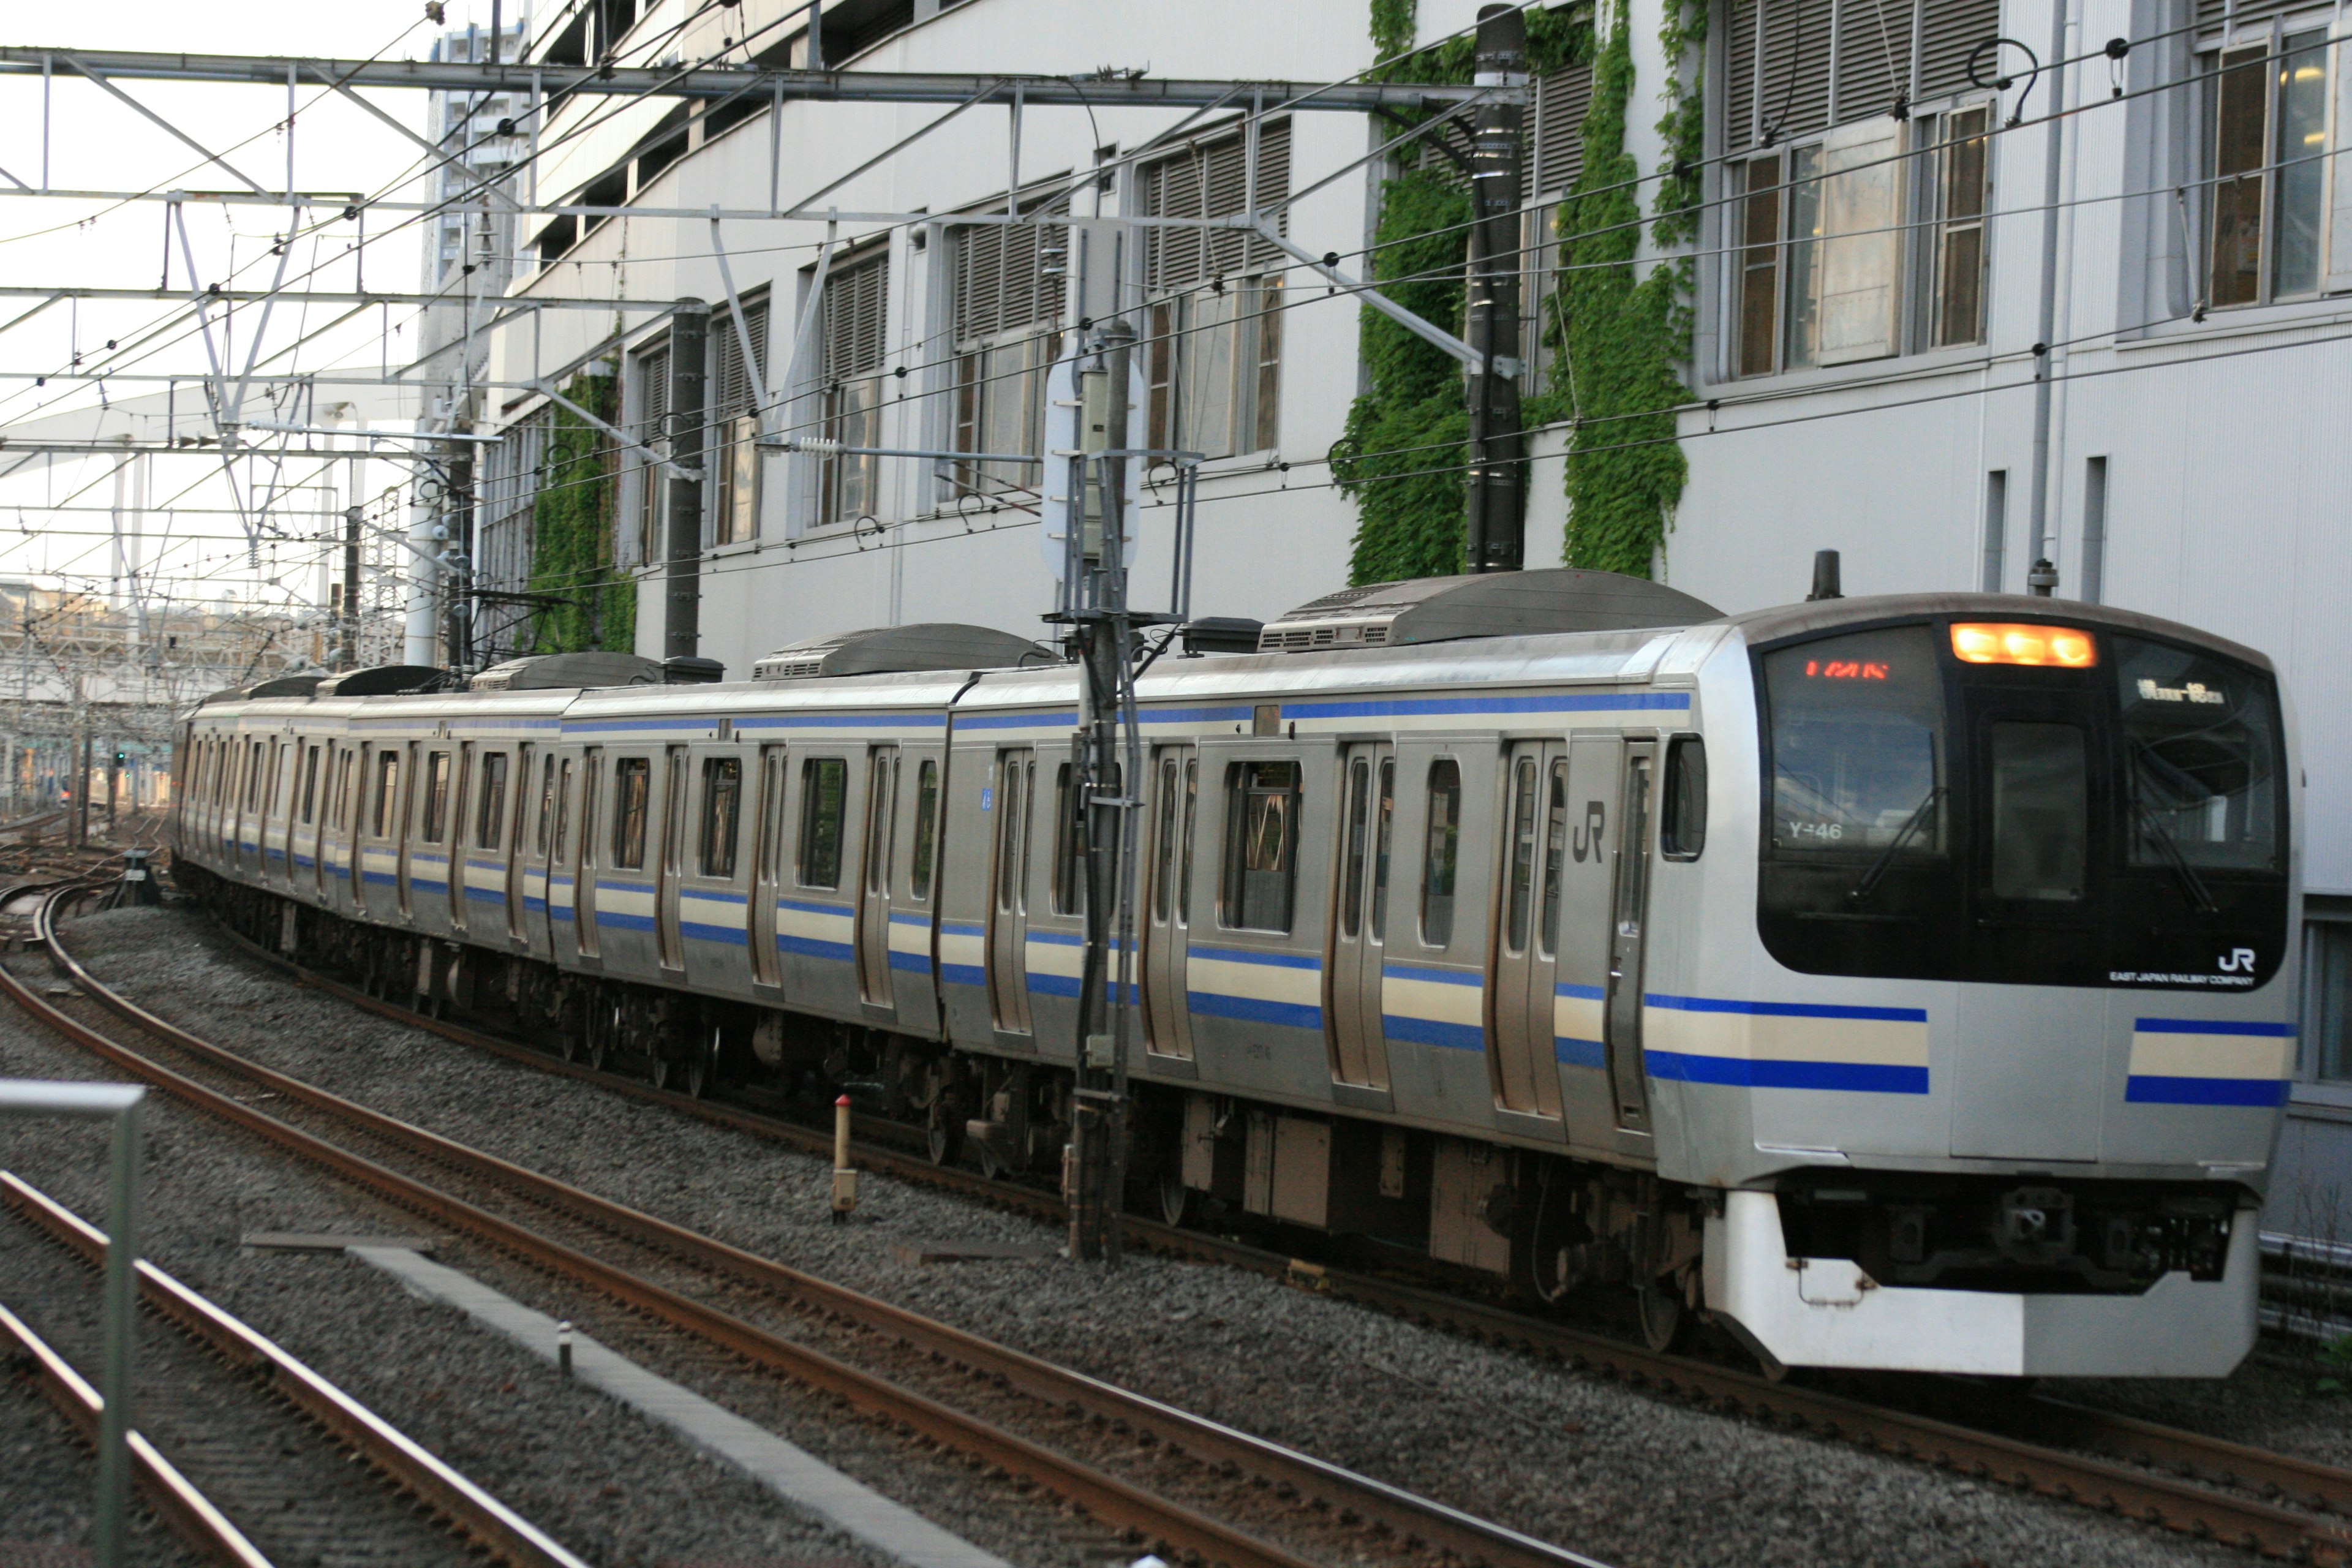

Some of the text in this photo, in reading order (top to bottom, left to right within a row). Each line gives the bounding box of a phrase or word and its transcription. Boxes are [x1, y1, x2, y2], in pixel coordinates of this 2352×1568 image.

[1573, 801, 1605, 864] JR
[1789, 822, 1842, 840] Y-46
[2218, 948, 2255, 972] JR
